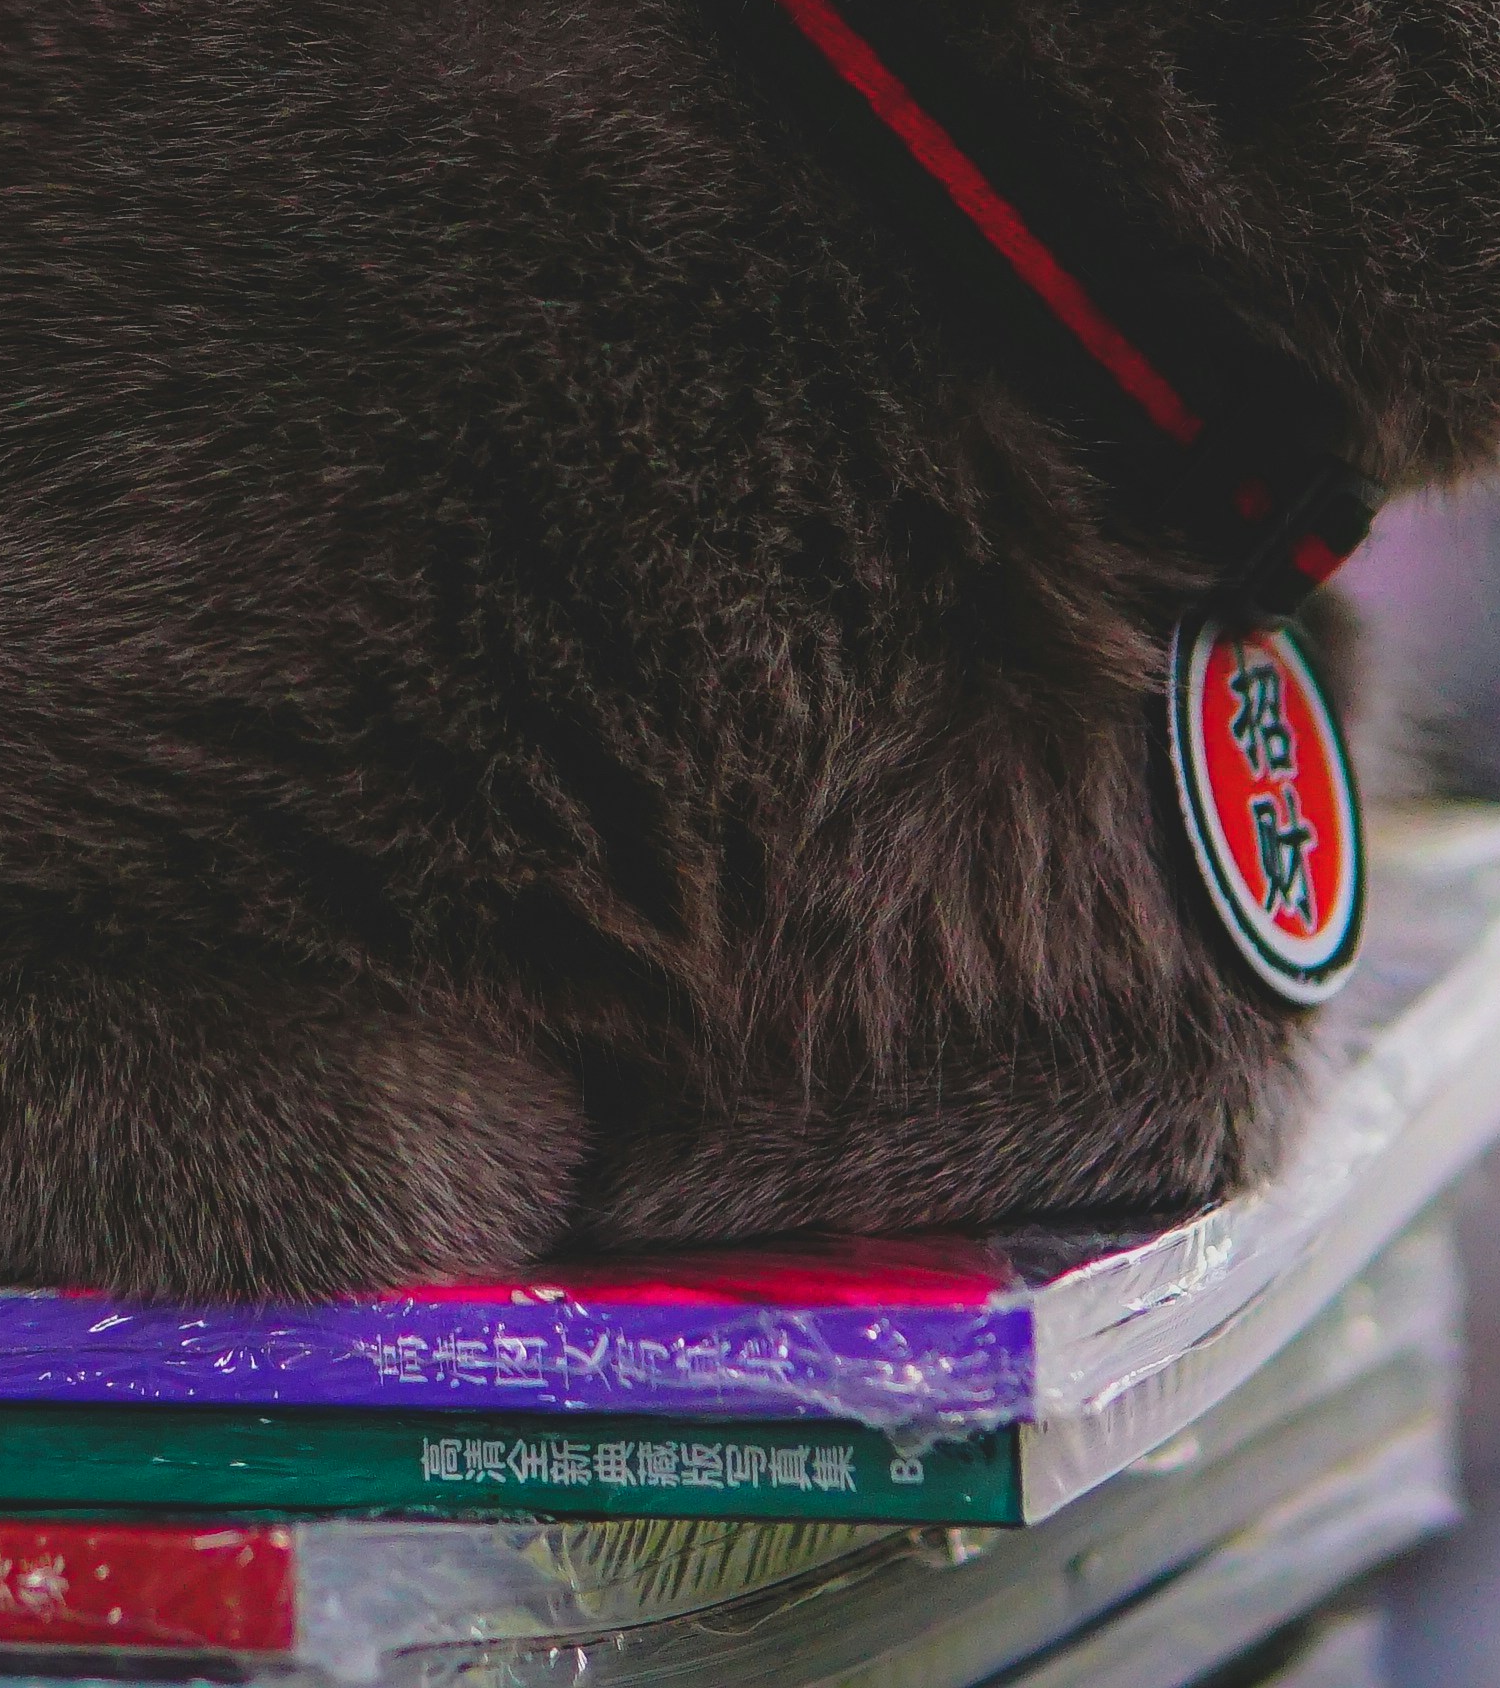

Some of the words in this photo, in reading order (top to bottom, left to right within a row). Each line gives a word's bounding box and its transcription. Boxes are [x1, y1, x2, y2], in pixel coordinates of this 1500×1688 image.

[1229, 638, 1316, 928] 招财
[421, 1437, 856, 1491] 高清全新典藏版写真集
